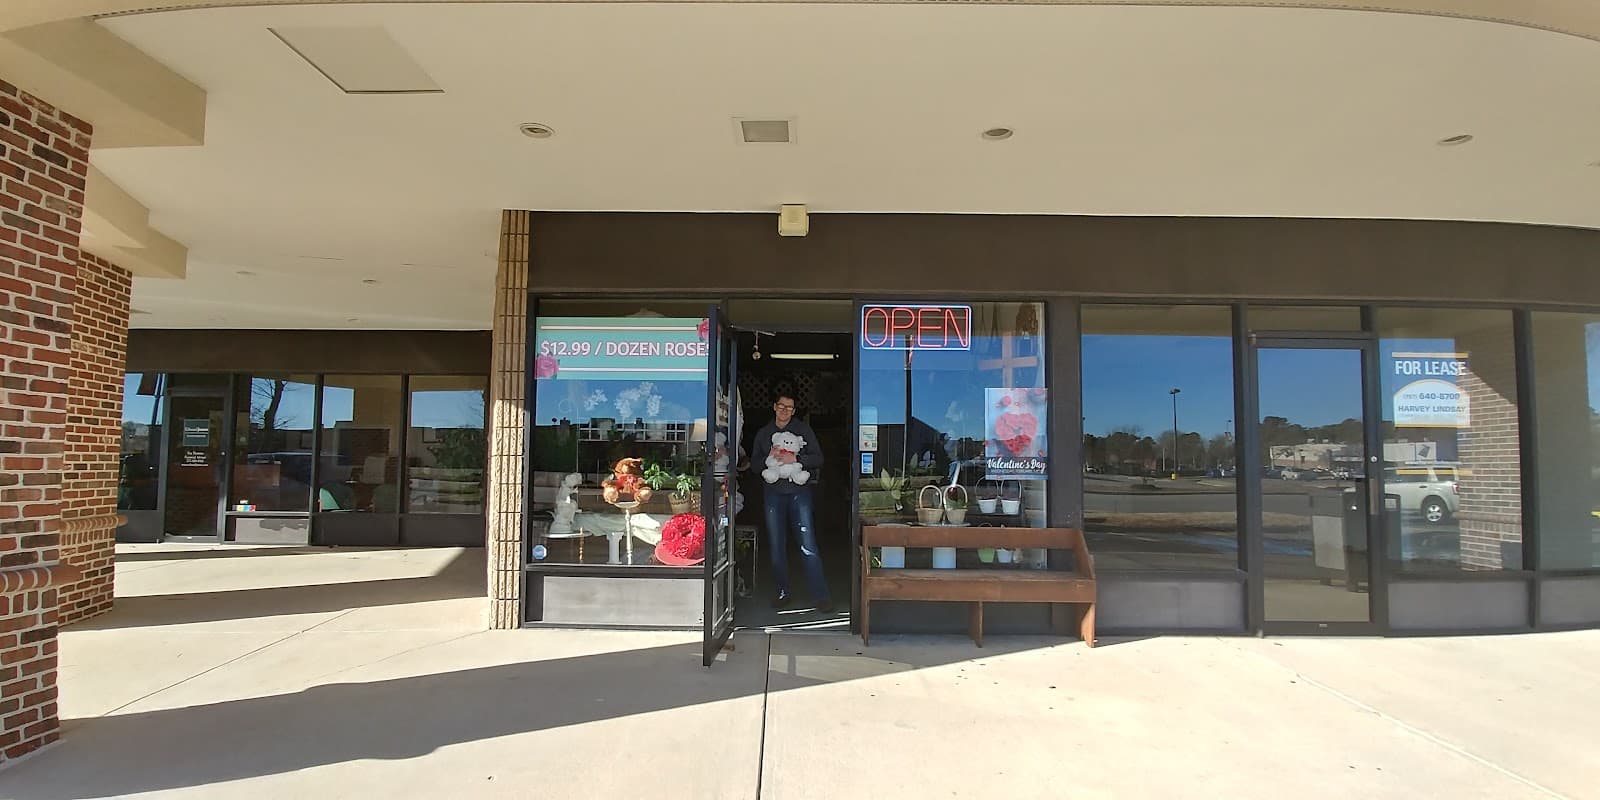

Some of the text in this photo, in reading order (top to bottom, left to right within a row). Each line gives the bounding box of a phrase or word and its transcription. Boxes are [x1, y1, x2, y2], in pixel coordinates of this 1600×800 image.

[864, 307, 969, 348] OPEN
[541, 340, 591, 356] $12.99
[594, 341, 603, 356] /
[606, 341, 660, 356] DOZEN
[1395, 360, 1466, 376] FOR LEASE
[1398, 405, 1466, 413] HARVEY LINDSAY
[986, 457, 1046, 474] Valentine's Day
